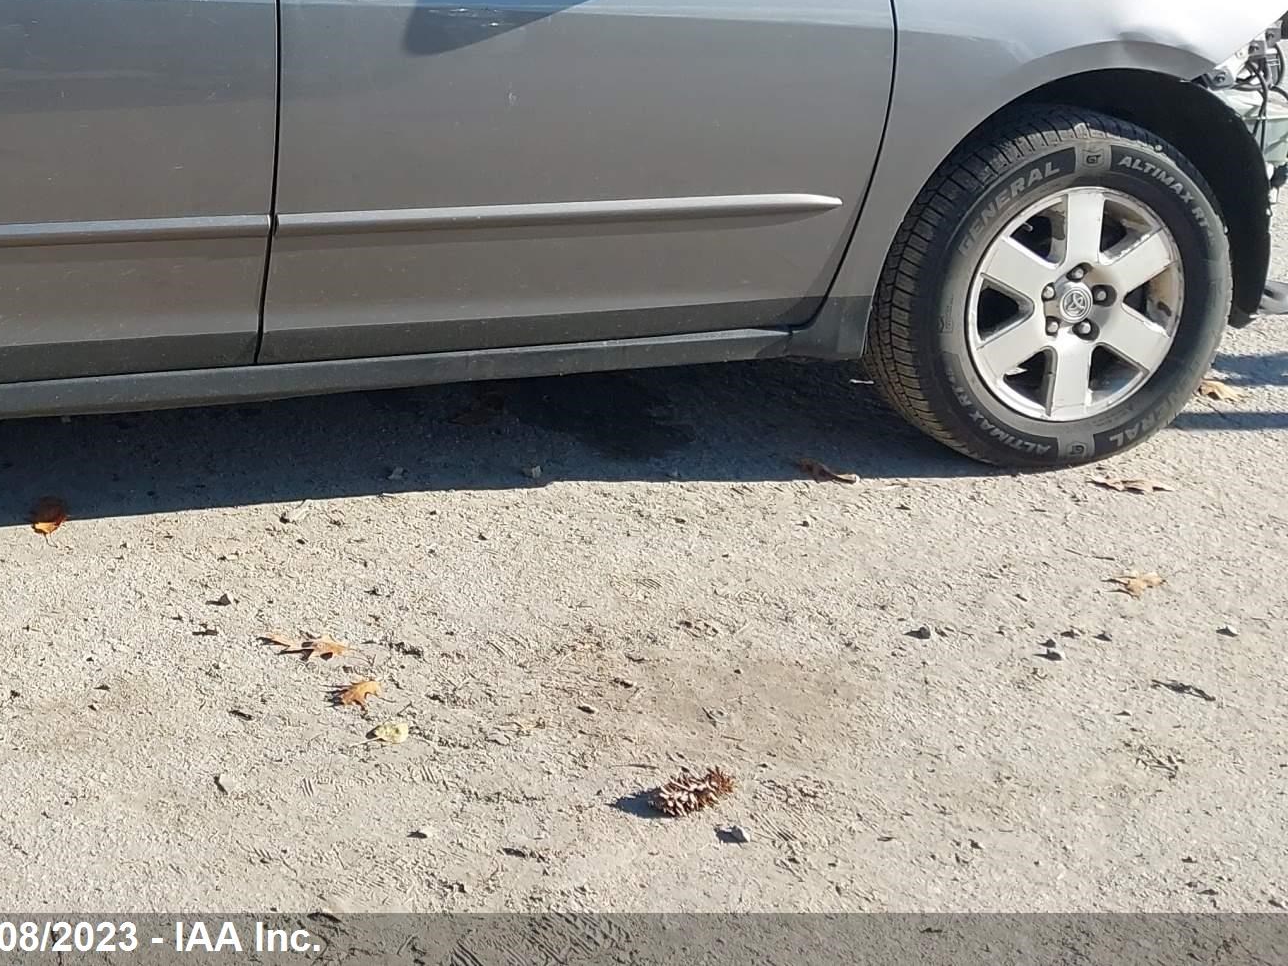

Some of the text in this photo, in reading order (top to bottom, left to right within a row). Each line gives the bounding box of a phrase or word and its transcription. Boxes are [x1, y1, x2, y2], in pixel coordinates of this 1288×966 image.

[1118, 156, 1195, 203] ALTIMAX
[959, 161, 1061, 256] GENERAL
[969, 410, 1052, 454] ALTIMAX
